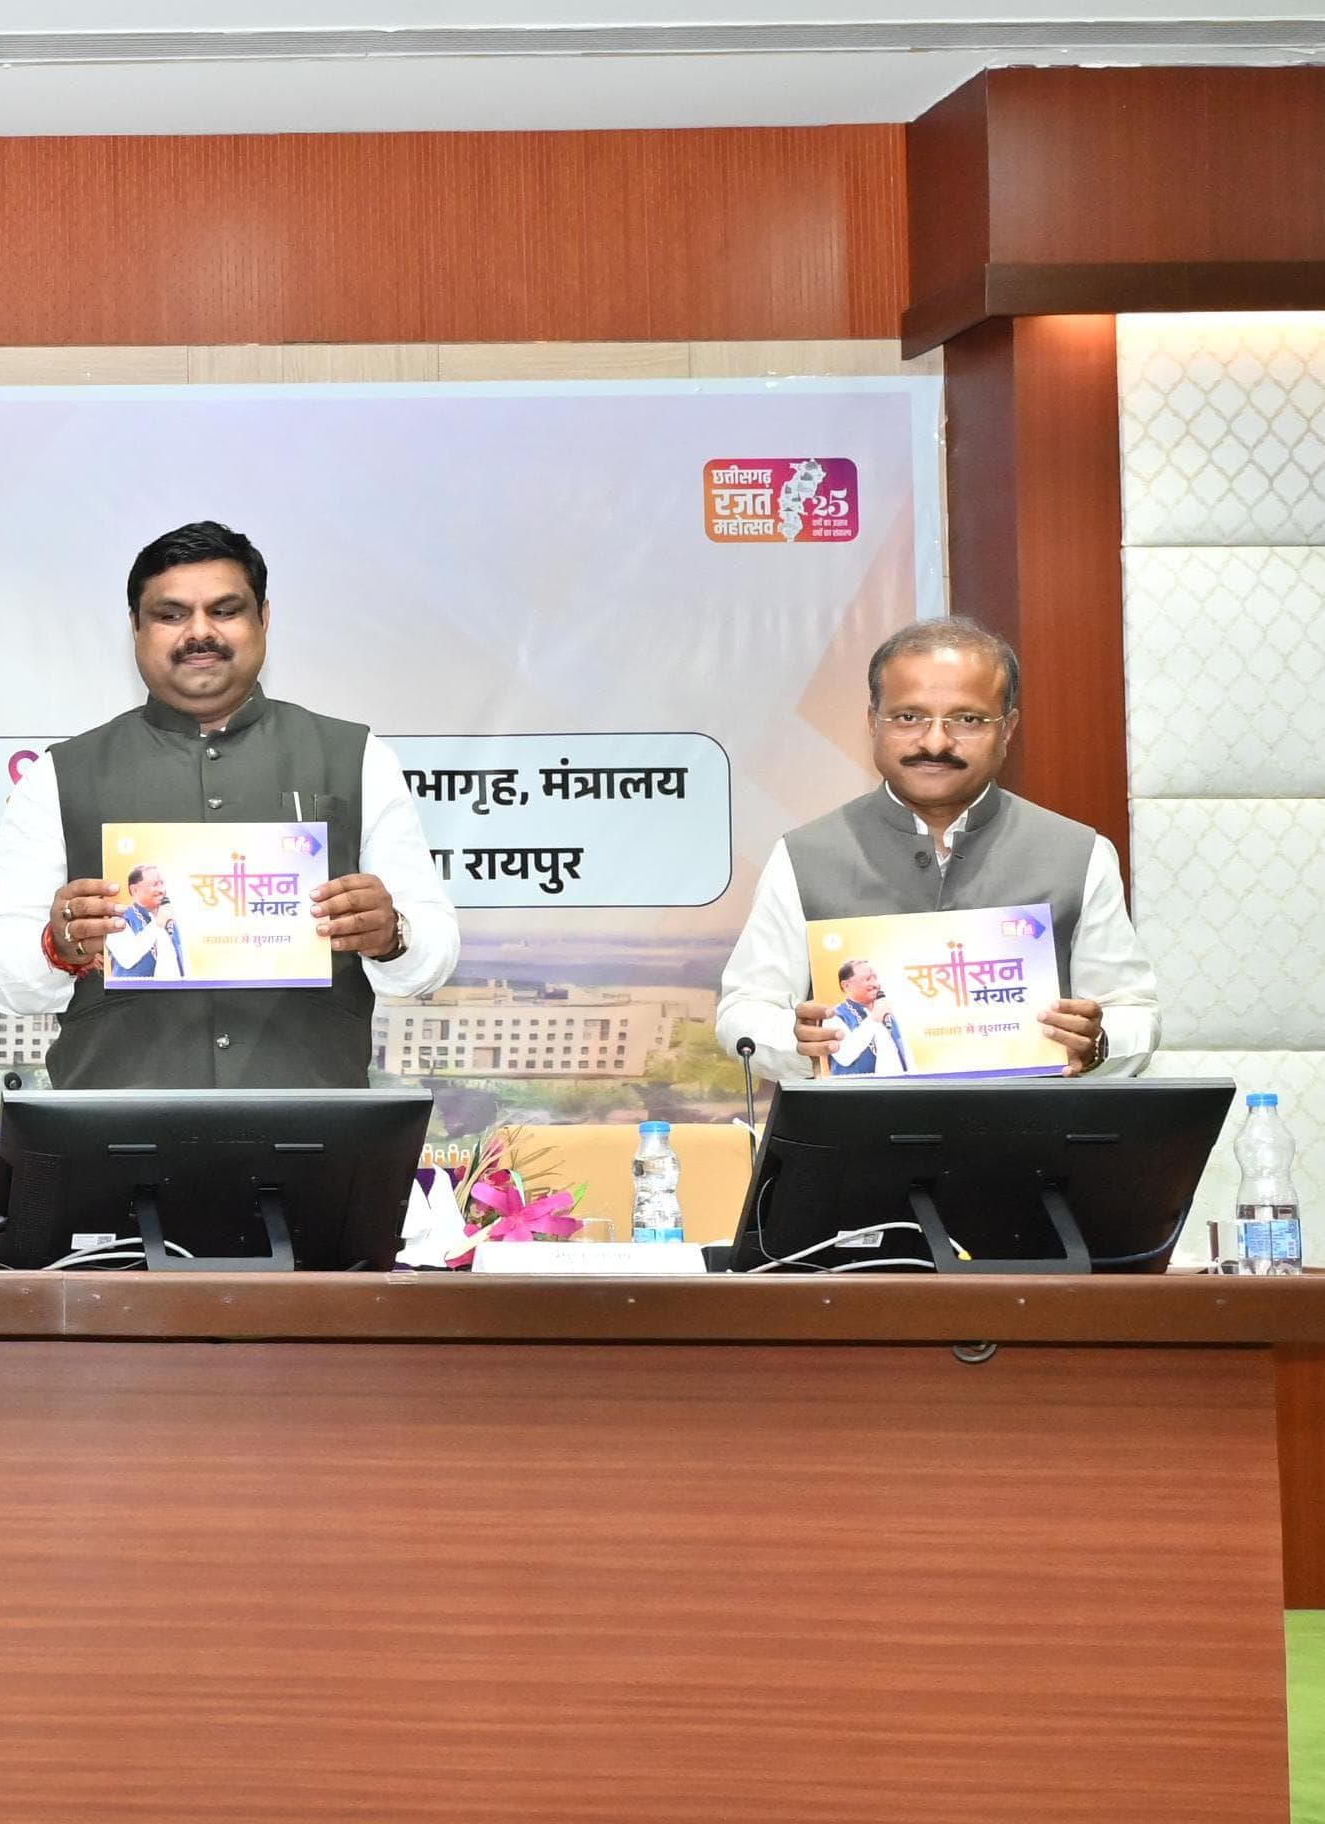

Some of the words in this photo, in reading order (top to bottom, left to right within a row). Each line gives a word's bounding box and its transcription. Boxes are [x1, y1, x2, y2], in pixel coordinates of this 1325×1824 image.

[711, 488, 774, 516] रजत
[812, 488, 850, 518] 25
[712, 515, 775, 536] महोत्सव
[402, 769, 529, 816] भागृह,
[539, 757, 689, 800] मंत्रालय
[189, 852, 300, 917] सुशासन
[462, 847, 585, 894] रायपुर
[248, 898, 300, 917] संवाद
[903, 941, 1024, 1008] सुशासन
[970, 984, 1028, 1006] संवाद
[978, 1022, 1020, 1037] सुशासन
